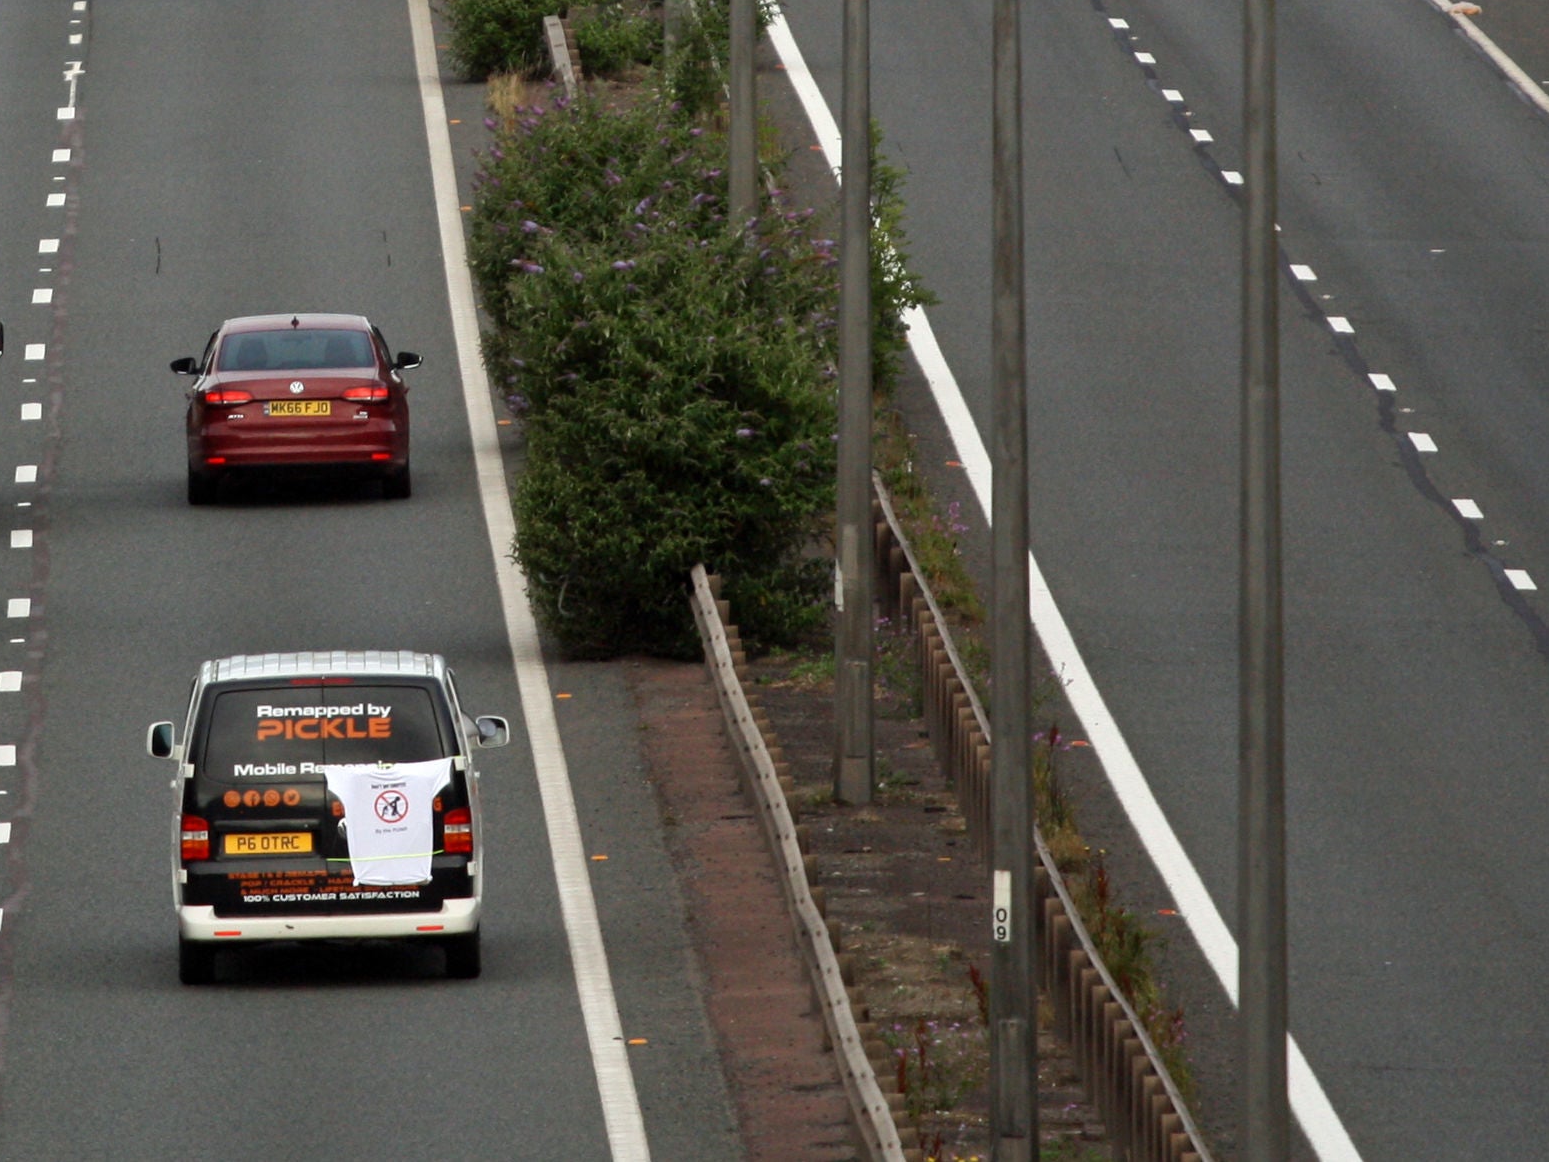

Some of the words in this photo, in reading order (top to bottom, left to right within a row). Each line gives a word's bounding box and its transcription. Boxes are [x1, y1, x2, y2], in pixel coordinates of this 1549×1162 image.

[257, 704, 363, 718] Remapped
[368, 703, 391, 718] by
[257, 718, 391, 741] PICKLE
[234, 763, 296, 776] Mobile
[237, 837, 256, 851] P6
[243, 895, 270, 903] 100%
[272, 893, 337, 902] CUSTOMER
[339, 891, 420, 900] SATISFACTION
